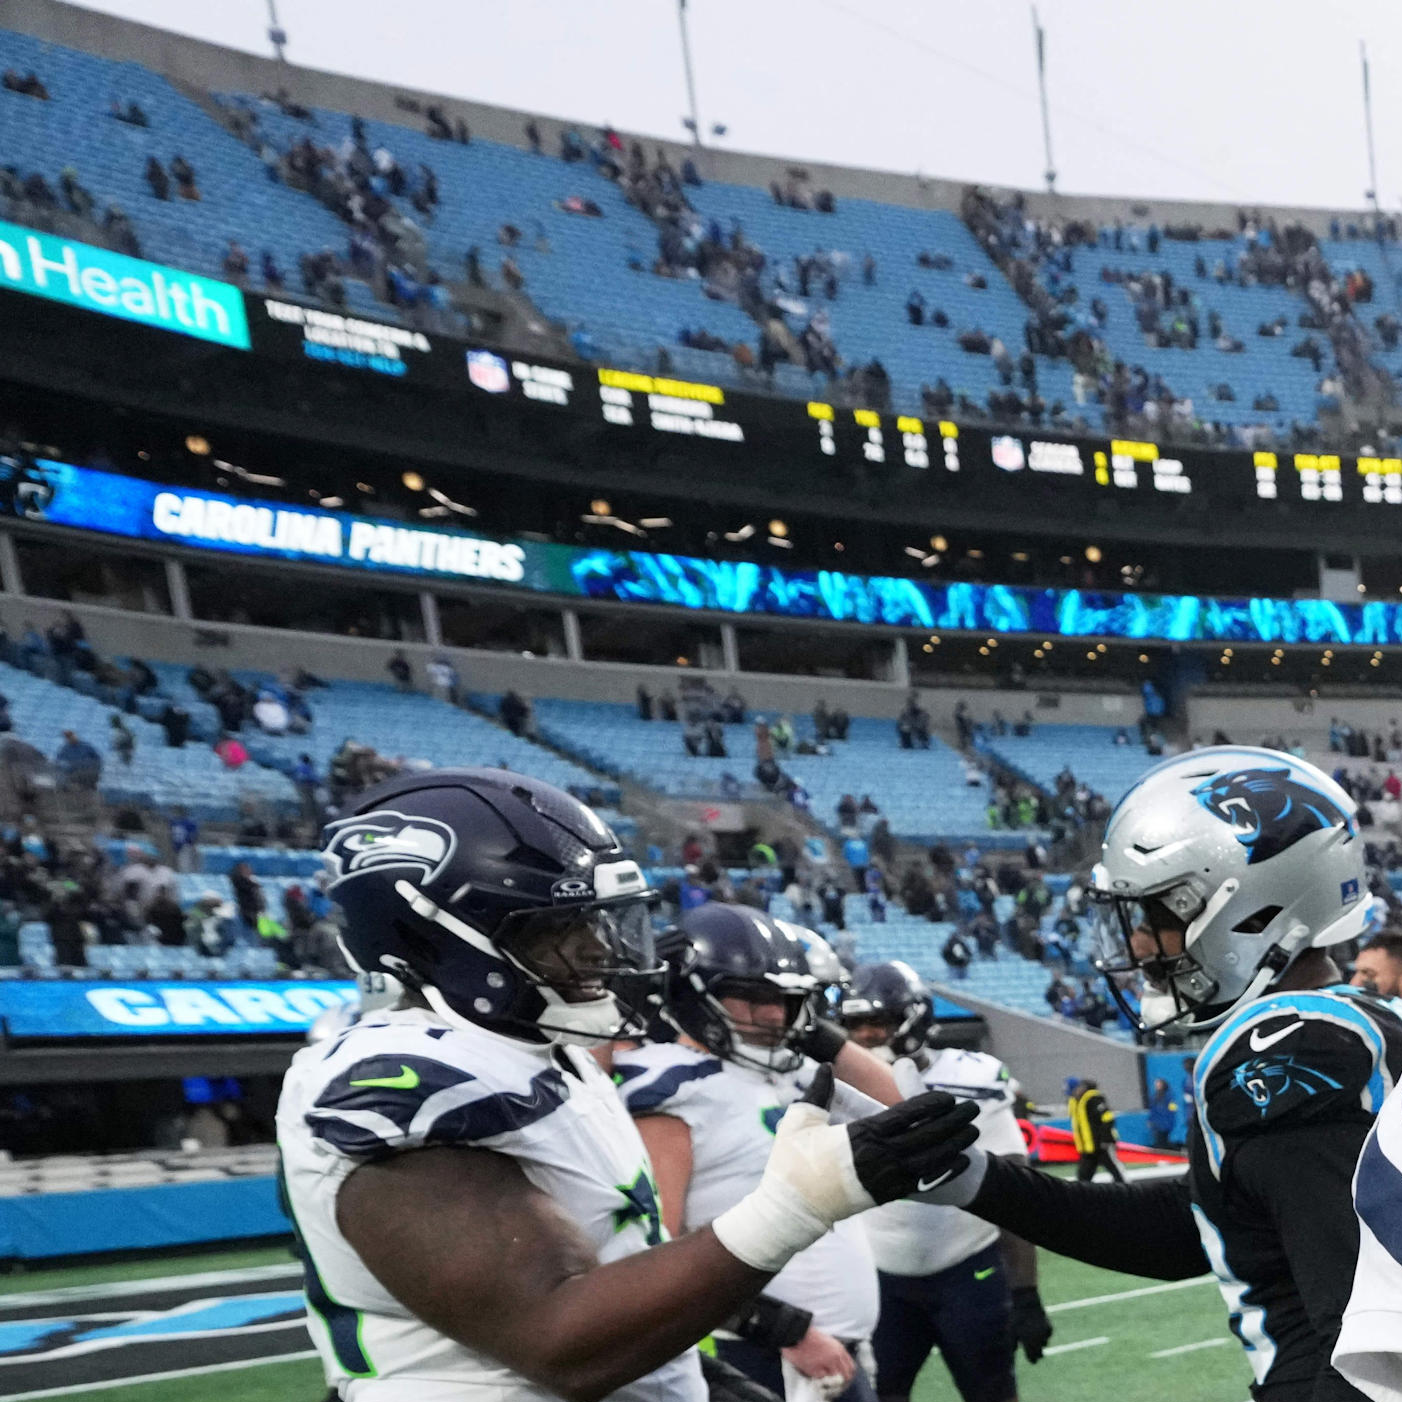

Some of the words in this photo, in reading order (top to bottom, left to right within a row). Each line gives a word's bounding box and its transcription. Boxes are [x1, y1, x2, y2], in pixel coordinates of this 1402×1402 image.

[26, 235, 231, 336] Health
[153, 492, 342, 558] CAROLINA
[347, 520, 526, 583] PANTHERS
[85, 987, 361, 1026] CARO
